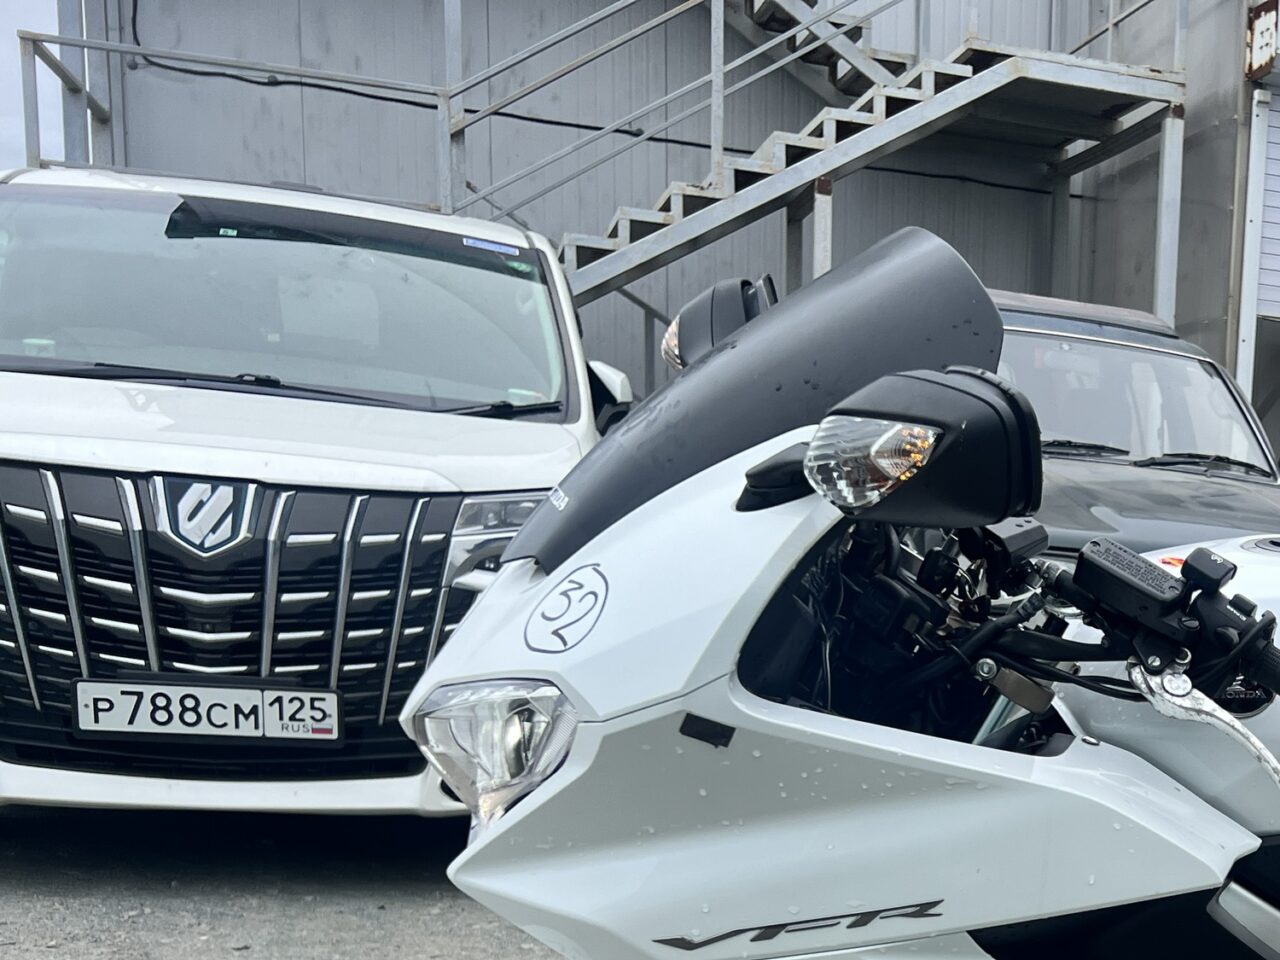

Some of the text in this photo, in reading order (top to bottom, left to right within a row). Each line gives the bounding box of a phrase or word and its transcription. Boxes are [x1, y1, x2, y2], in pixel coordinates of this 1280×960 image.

[540, 579, 599, 649] 32
[268, 695, 328, 723] 125
[281, 723, 310, 734] RUS
[651, 898, 945, 951] VFR
